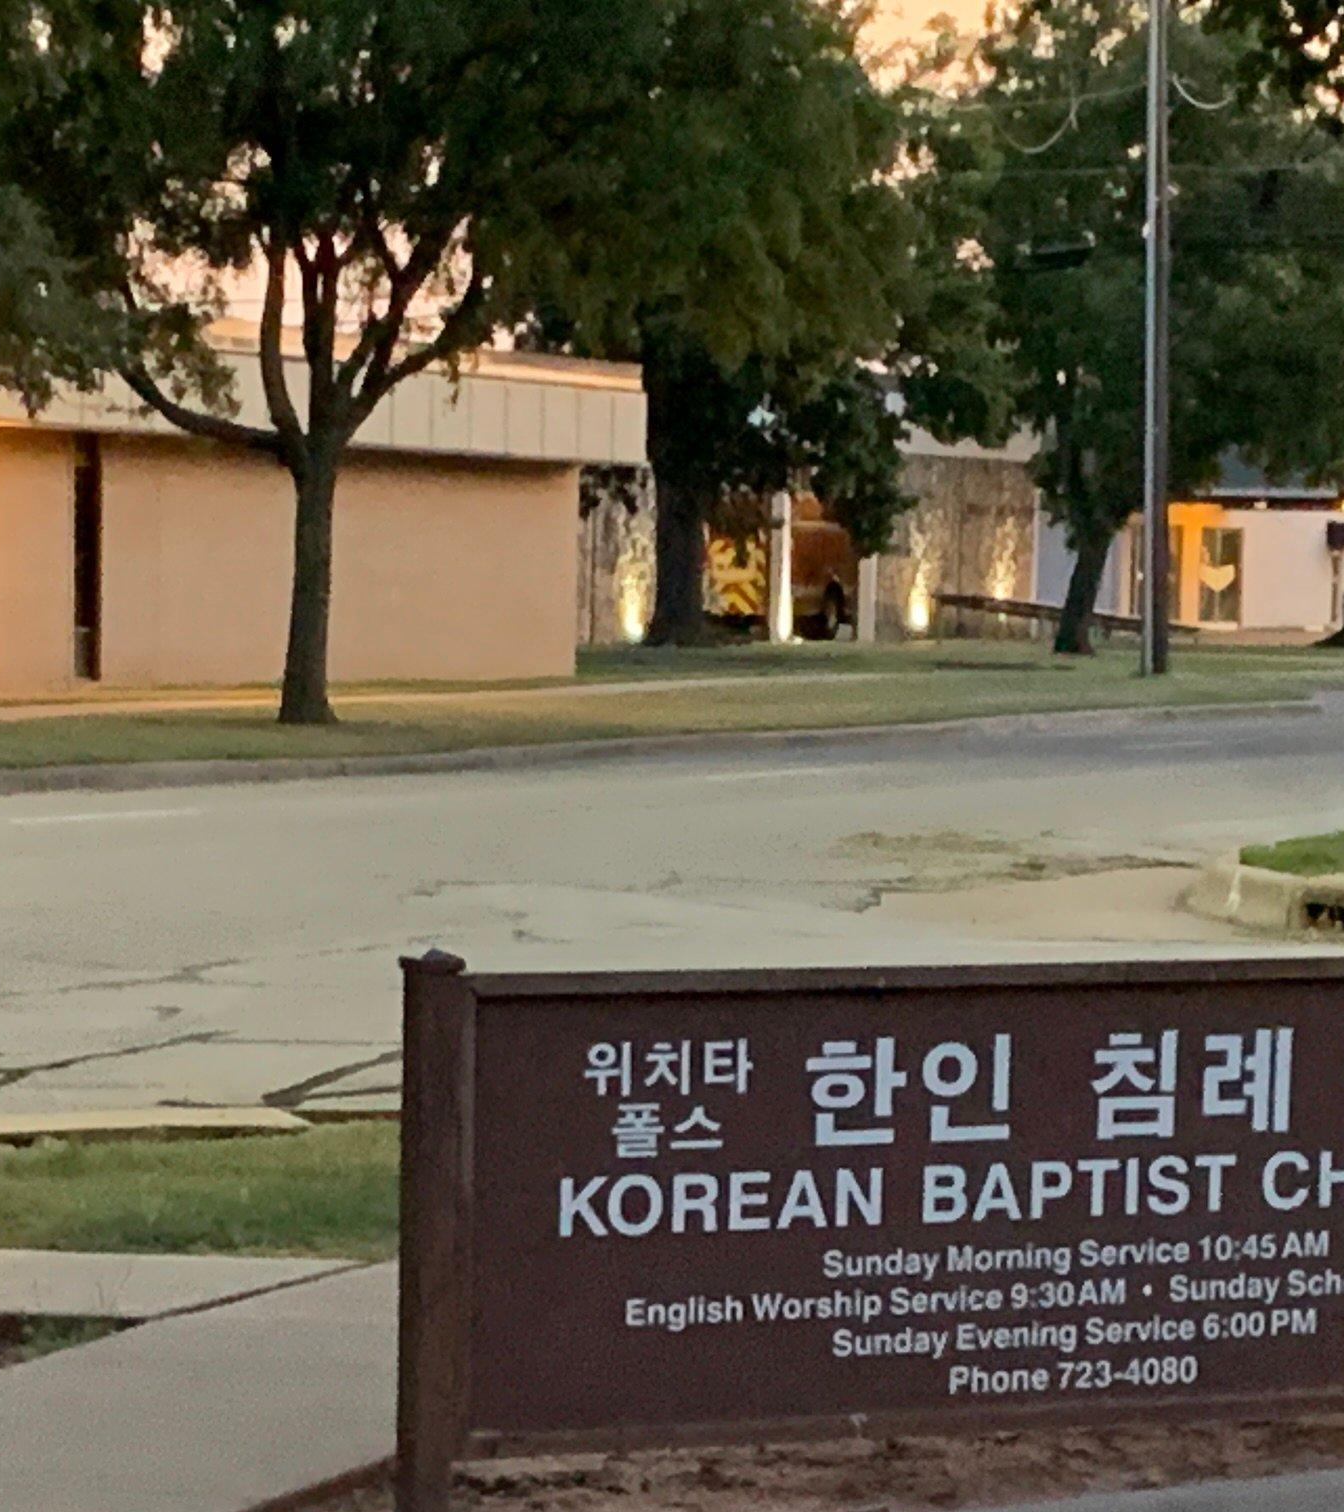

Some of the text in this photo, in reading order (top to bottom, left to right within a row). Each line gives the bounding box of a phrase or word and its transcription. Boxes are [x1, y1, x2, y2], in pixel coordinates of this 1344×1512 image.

[584, 1038, 754, 1097] 위치타
[805, 1033, 1012, 1146] 한인
[1090, 1027, 1294, 1140] 침례
[612, 1102, 724, 1158] 폴스
[558, 1166, 884, 1238] KOREAN
[922, 1153, 1238, 1225] BAPTIST
[823, 1230, 1330, 1281] Sunday Morning Service 10:45 AM
[625, 1295, 744, 1332] English
[751, 1289, 883, 1323] Worship
[890, 1285, 1004, 1315] Service
[1169, 1273, 1280, 1305] Sunday
[832, 1307, 1317, 1359] Sunday Evening Service 6:00 PM
[949, 1355, 1199, 1395] Phone 723-4080
